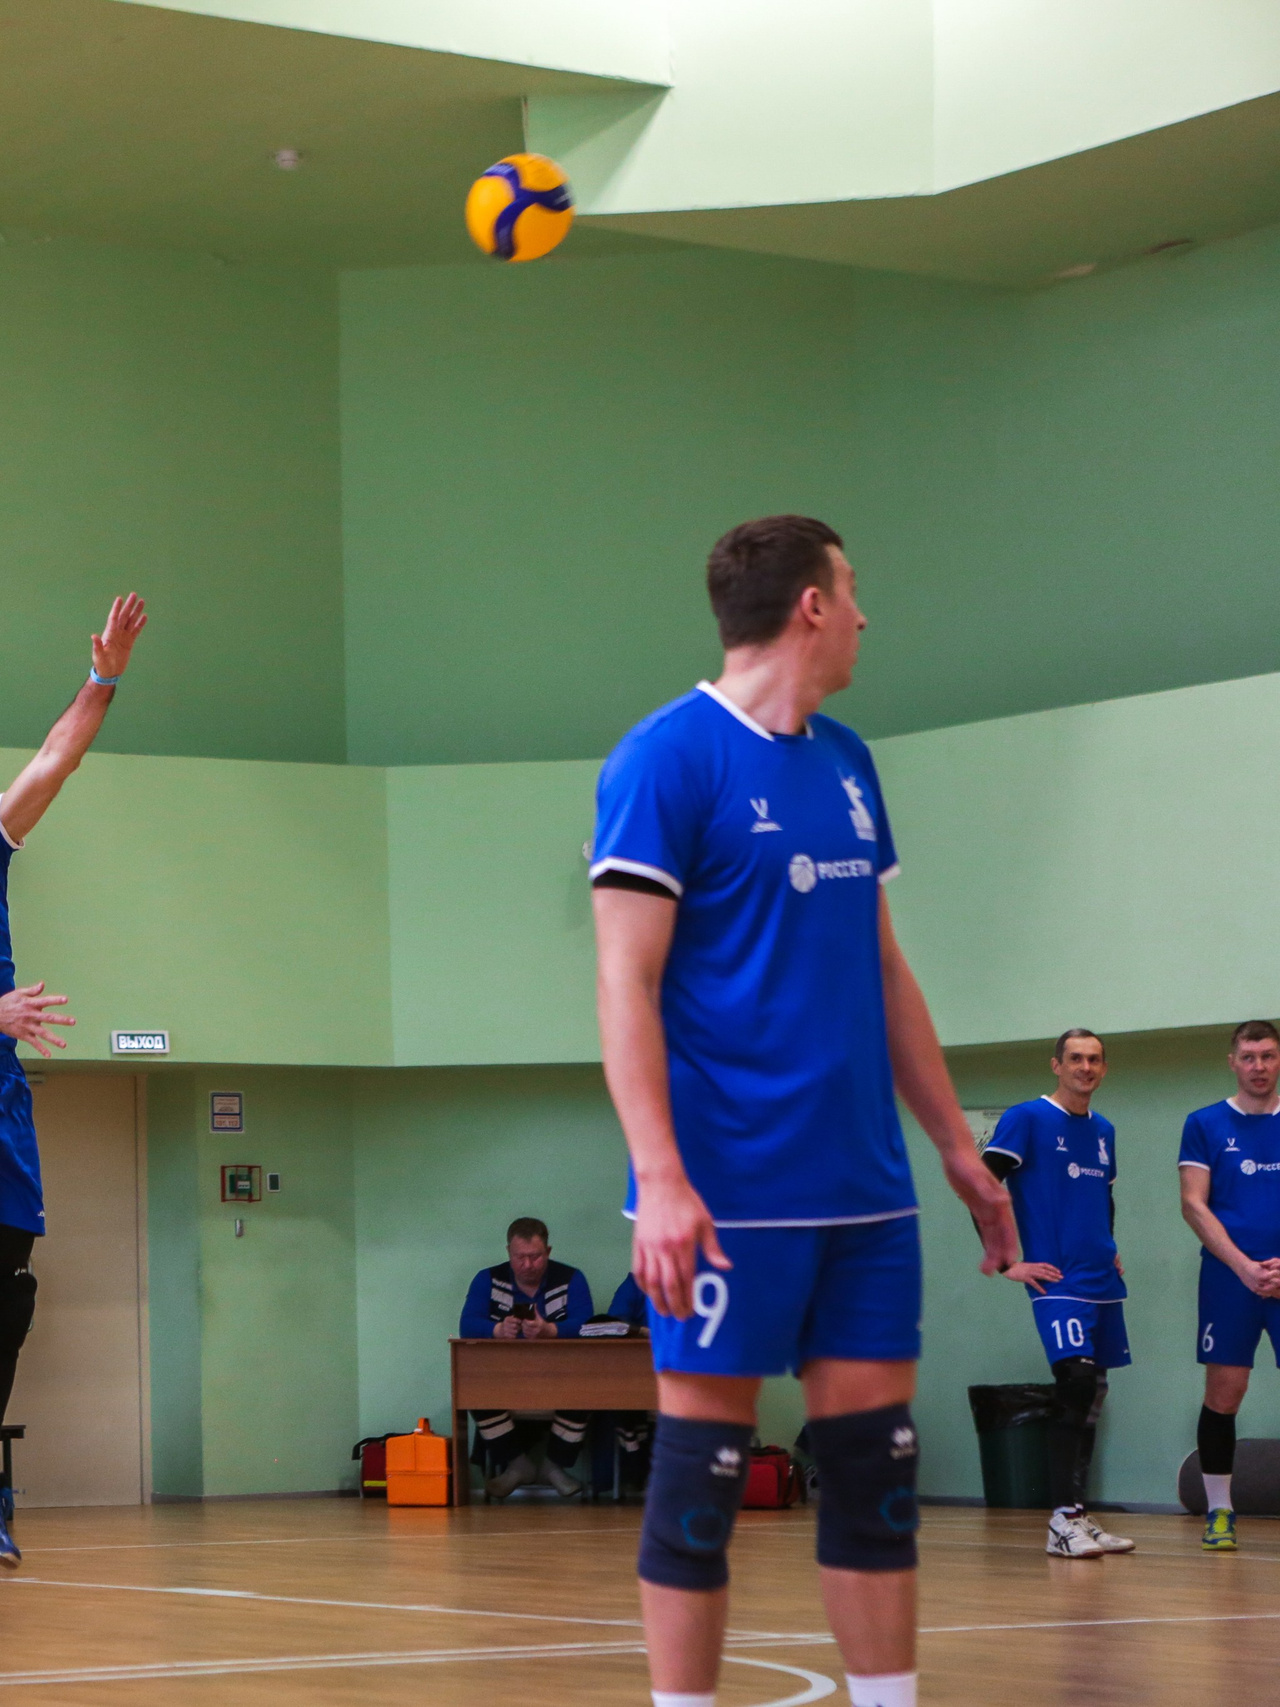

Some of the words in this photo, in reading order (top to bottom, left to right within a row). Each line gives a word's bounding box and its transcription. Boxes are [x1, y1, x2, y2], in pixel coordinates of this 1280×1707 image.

[118, 1035, 165, 1049] ВЫХОД
[693, 1272, 729, 1348] 9
[1051, 1318, 1084, 1349] 10
[1202, 1323, 1214, 1352] 6
